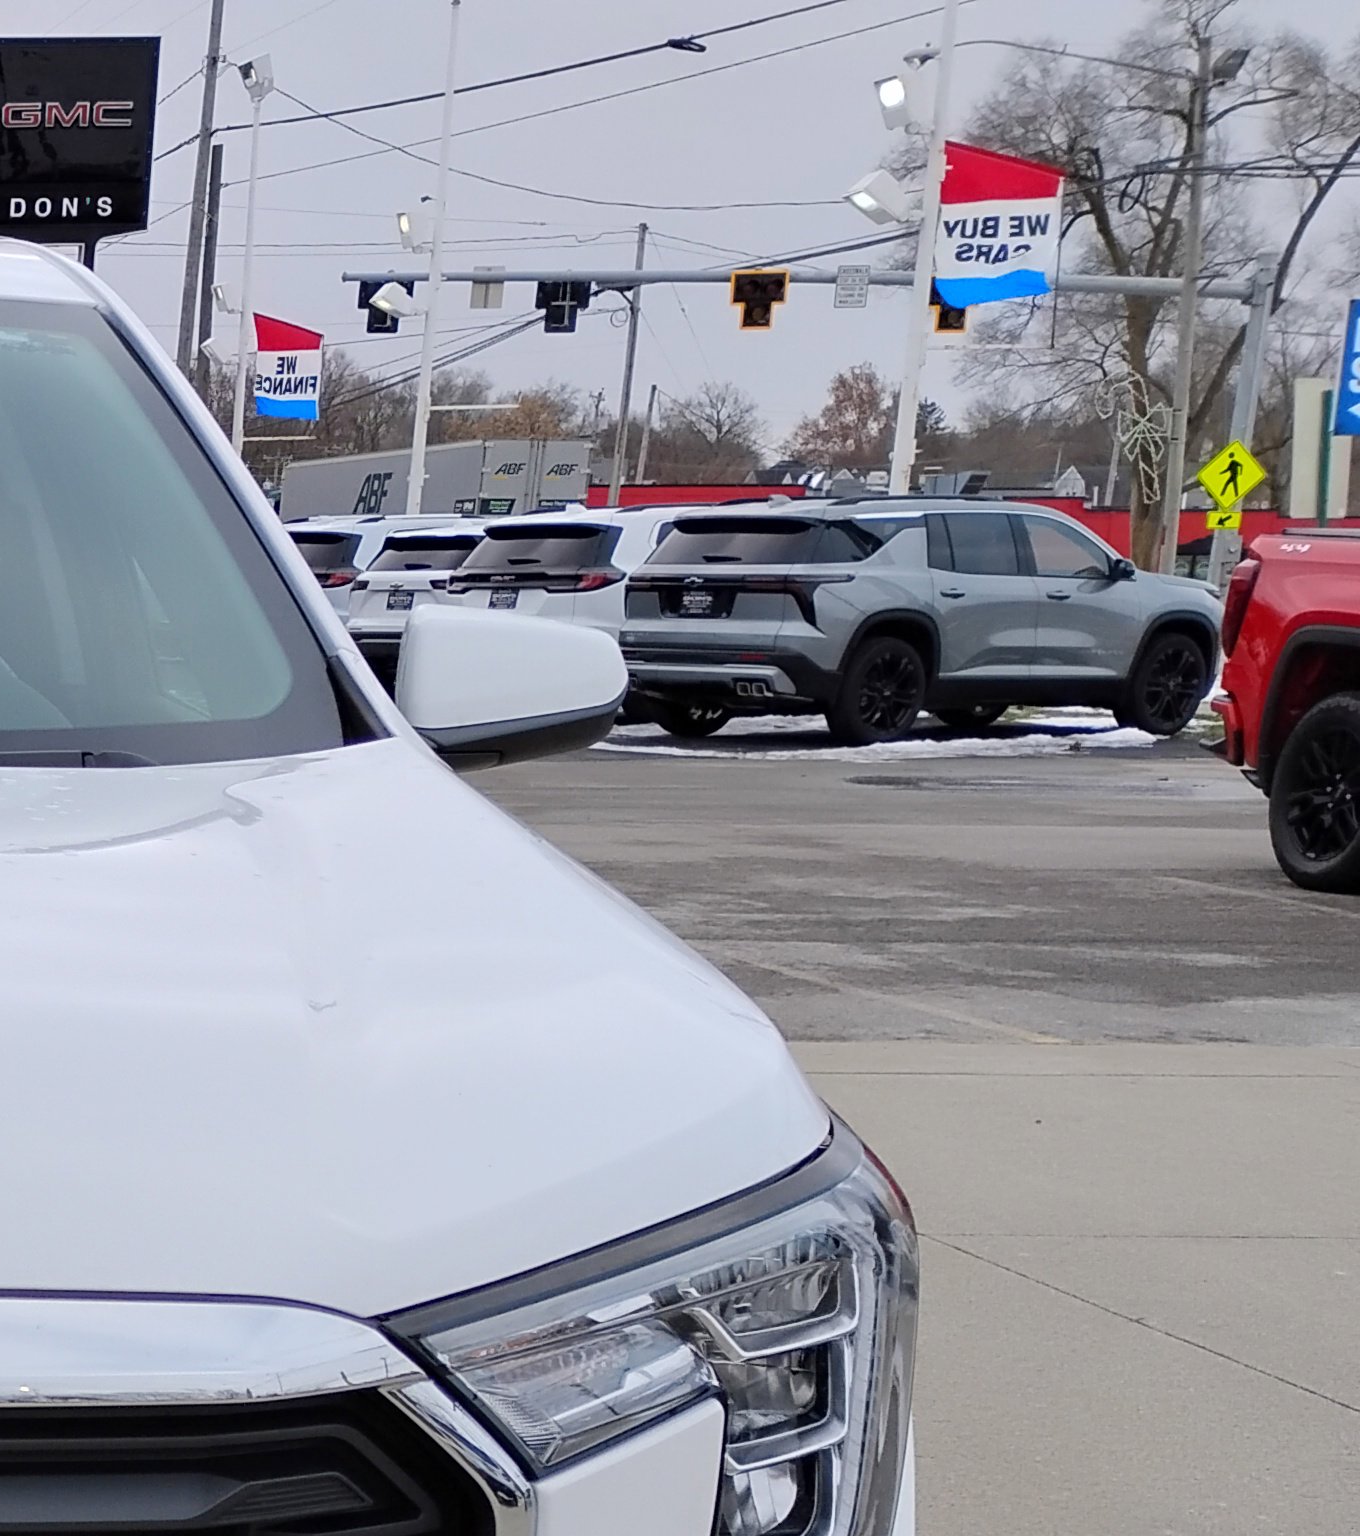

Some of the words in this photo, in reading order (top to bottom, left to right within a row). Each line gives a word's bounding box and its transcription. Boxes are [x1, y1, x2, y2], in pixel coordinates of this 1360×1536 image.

[1, 101, 134, 128] GMC
[9, 196, 113, 218] DON'S
[494, 462, 527, 476] ABF
[546, 463, 579, 477] ABF
[352, 472, 394, 514] ABF
